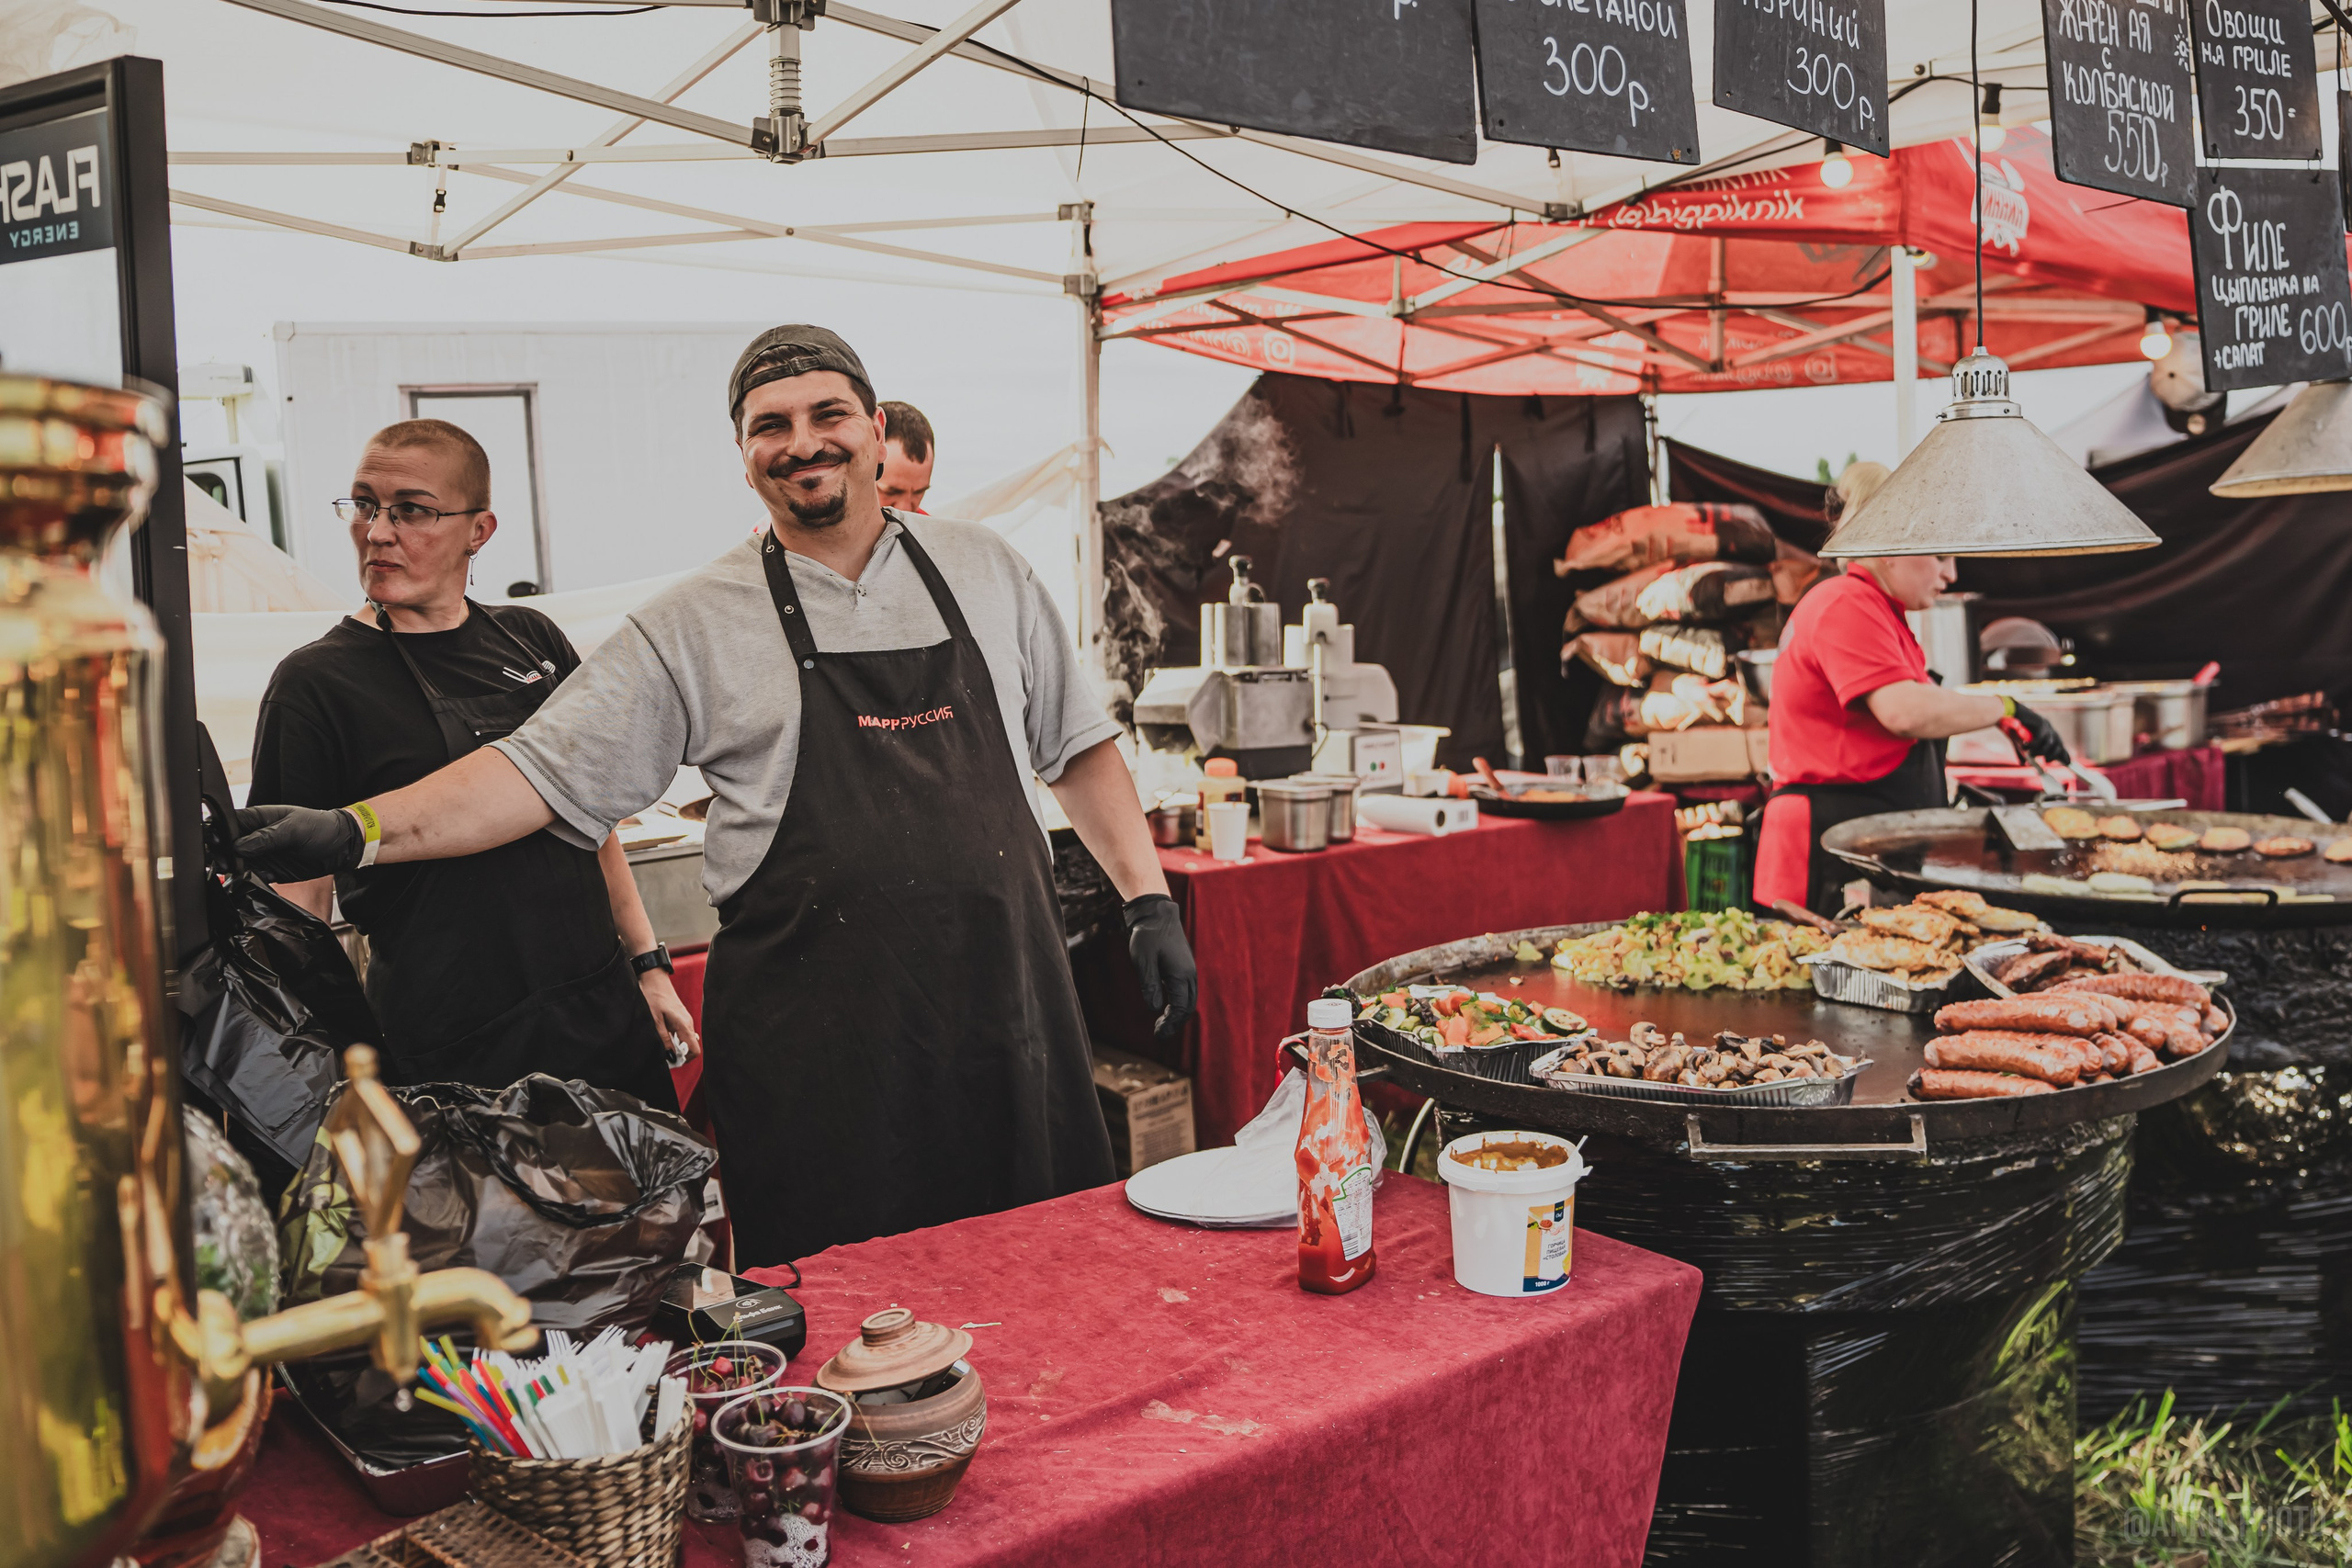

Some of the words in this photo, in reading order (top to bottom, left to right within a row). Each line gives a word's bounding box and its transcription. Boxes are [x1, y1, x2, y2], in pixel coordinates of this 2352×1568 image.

[1743, 0, 1860, 50] РИНЫЙ
[2233, 45, 2292, 78] ГРИЛЕ
[2063, 60, 2176, 123] КОЛБАСКОЙ
[2211, 274, 2300, 308] ЦЫПЛЕНКА
[2234, 303, 2293, 341] ГРИЛЕ
